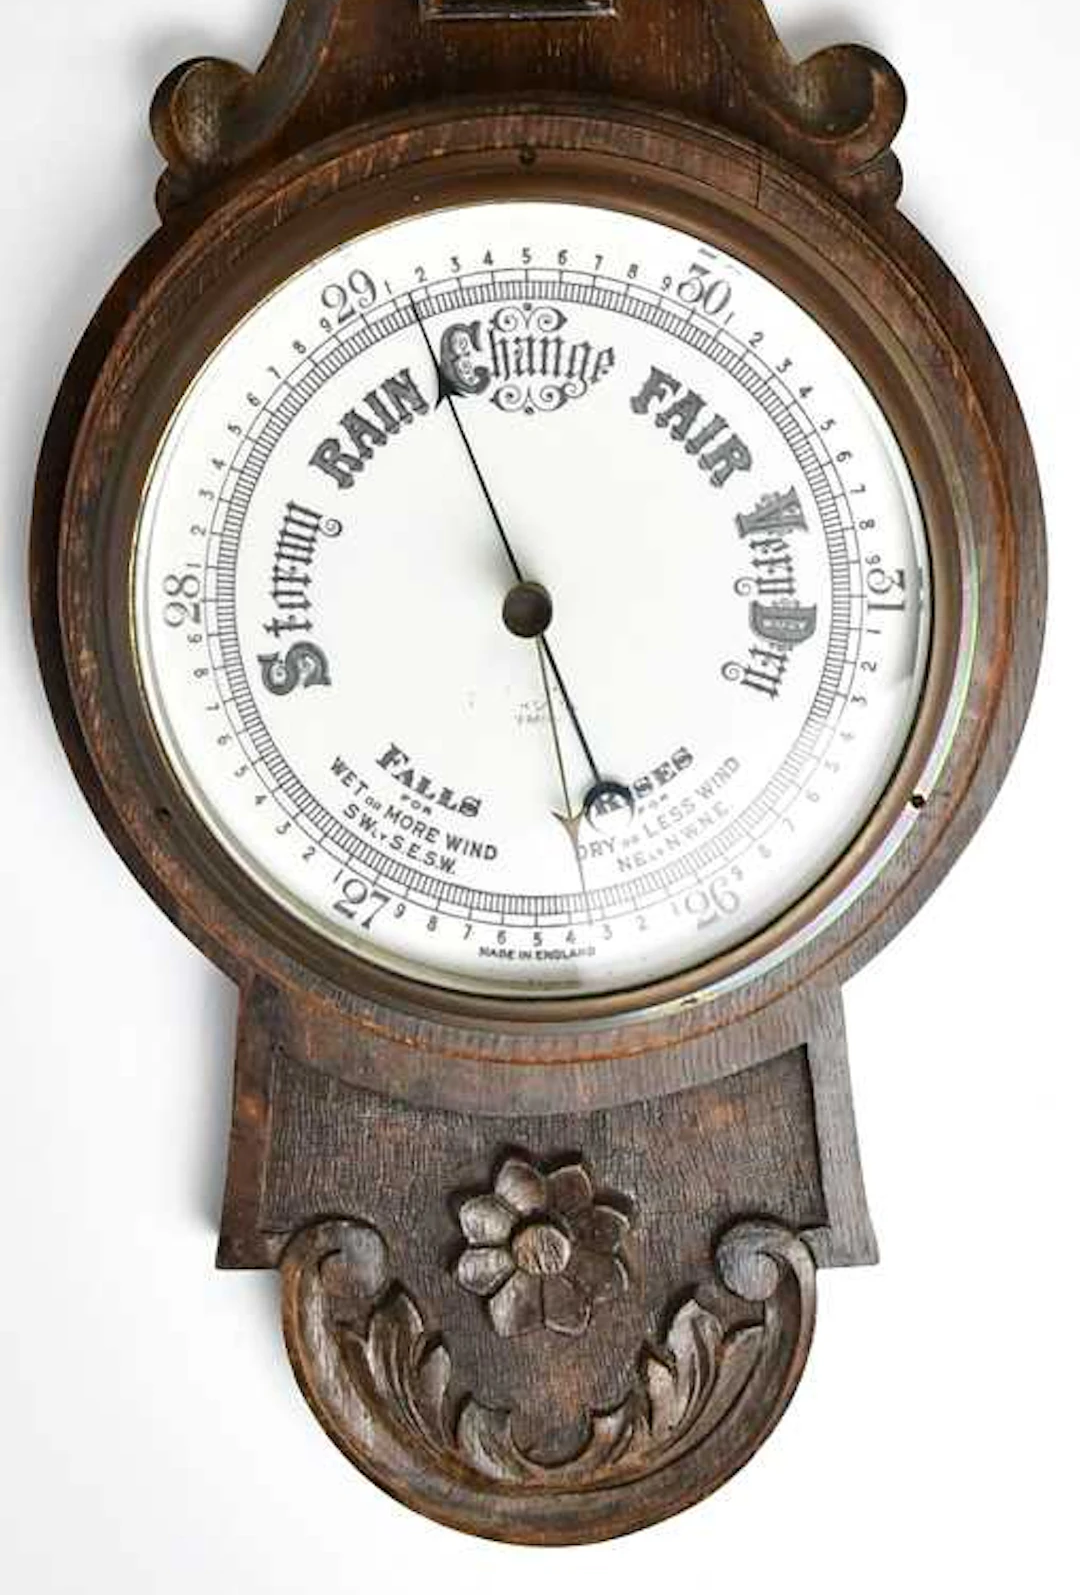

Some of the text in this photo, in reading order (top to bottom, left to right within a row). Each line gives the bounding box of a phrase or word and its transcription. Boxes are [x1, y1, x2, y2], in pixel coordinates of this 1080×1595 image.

[483, 250, 494, 266] 4
[522, 247, 532, 264] 5
[558, 249, 568, 266] 6
[595, 255, 604, 270] 7
[450, 256, 461, 273] 3
[627, 264, 638, 280] 8
[415, 266, 428, 283] 2
[661, 276, 672, 292] 9
[676, 263, 732, 316] 30
[321, 269, 376, 324] 29
[319, 317, 333, 332] 9
[292, 340, 307, 355] 8
[749, 331, 764, 349] 2
[440, 320, 615, 398] Change
[776, 357, 793, 373] 3
[267, 365, 281, 380] 7
[246, 392, 262, 407] 6
[799, 386, 813, 399] 4
[227, 423, 242, 437] 5
[308, 368, 430, 489] RAIN
[630, 365, 752, 488] FAIR
[820, 418, 837, 431] 5
[212, 457, 226, 471] 4
[836, 450, 854, 463] 6
[199, 488, 215, 501] 3
[850, 484, 866, 495] 7
[190, 524, 207, 537] 2
[859, 519, 876, 530] 8
[865, 554, 881, 565] 9
[256, 500, 342, 695] Stormy
[721, 485, 817, 701] Very Dry
[866, 568, 906, 614] 31
[163, 574, 202, 629] 28
[187, 634, 202, 644] 9
[193, 668, 209, 679] 8
[861, 661, 877, 673] 2
[206, 702, 220, 711] 7
[217, 733, 232, 746] 6
[234, 764, 249, 778] 5
[375, 742, 482, 817] FALLS
[593, 746, 693, 817] RSES
[255, 794, 268, 806] 4
[331, 756, 368, 797] WET
[383, 804, 441, 844] MORE
[445, 831, 498, 861] WIND
[577, 837, 616, 862] DRY
[643, 797, 696, 839] LESS
[695, 756, 741, 800] WIND
[275, 821, 292, 835] 3
[302, 846, 316, 862] 2
[332, 879, 391, 930] 27
[393, 903, 406, 919] 9
[427, 915, 438, 932] 8
[463, 924, 473, 940] 7
[497, 930, 507, 945] 6
[533, 932, 542, 947] 5
[565, 930, 576, 945] 4
[479, 946, 596, 960] MADE IN ENGLAND
